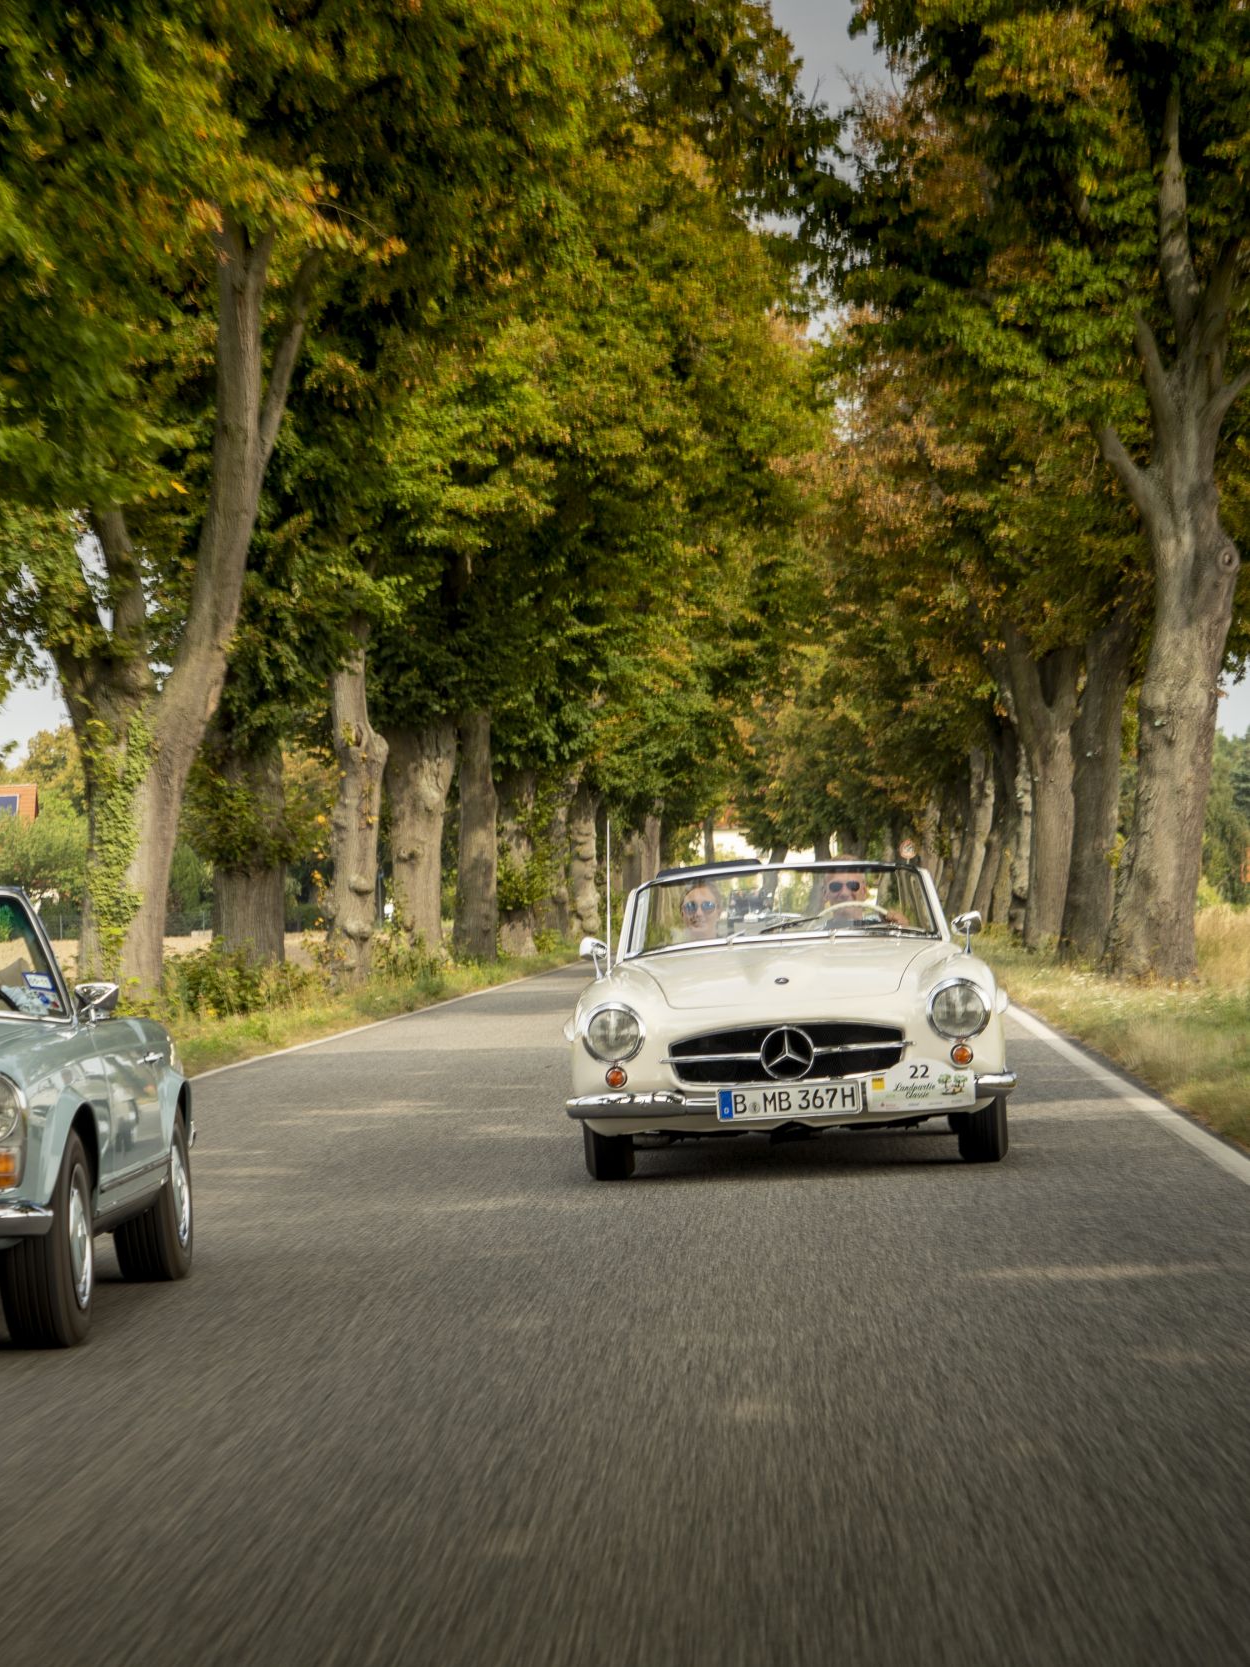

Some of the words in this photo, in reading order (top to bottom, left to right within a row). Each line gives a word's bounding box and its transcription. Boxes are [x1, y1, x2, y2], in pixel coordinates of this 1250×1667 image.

[909, 1064, 930, 1080] 22
[733, 1094, 747, 1114] B
[763, 1091, 792, 1113] MB
